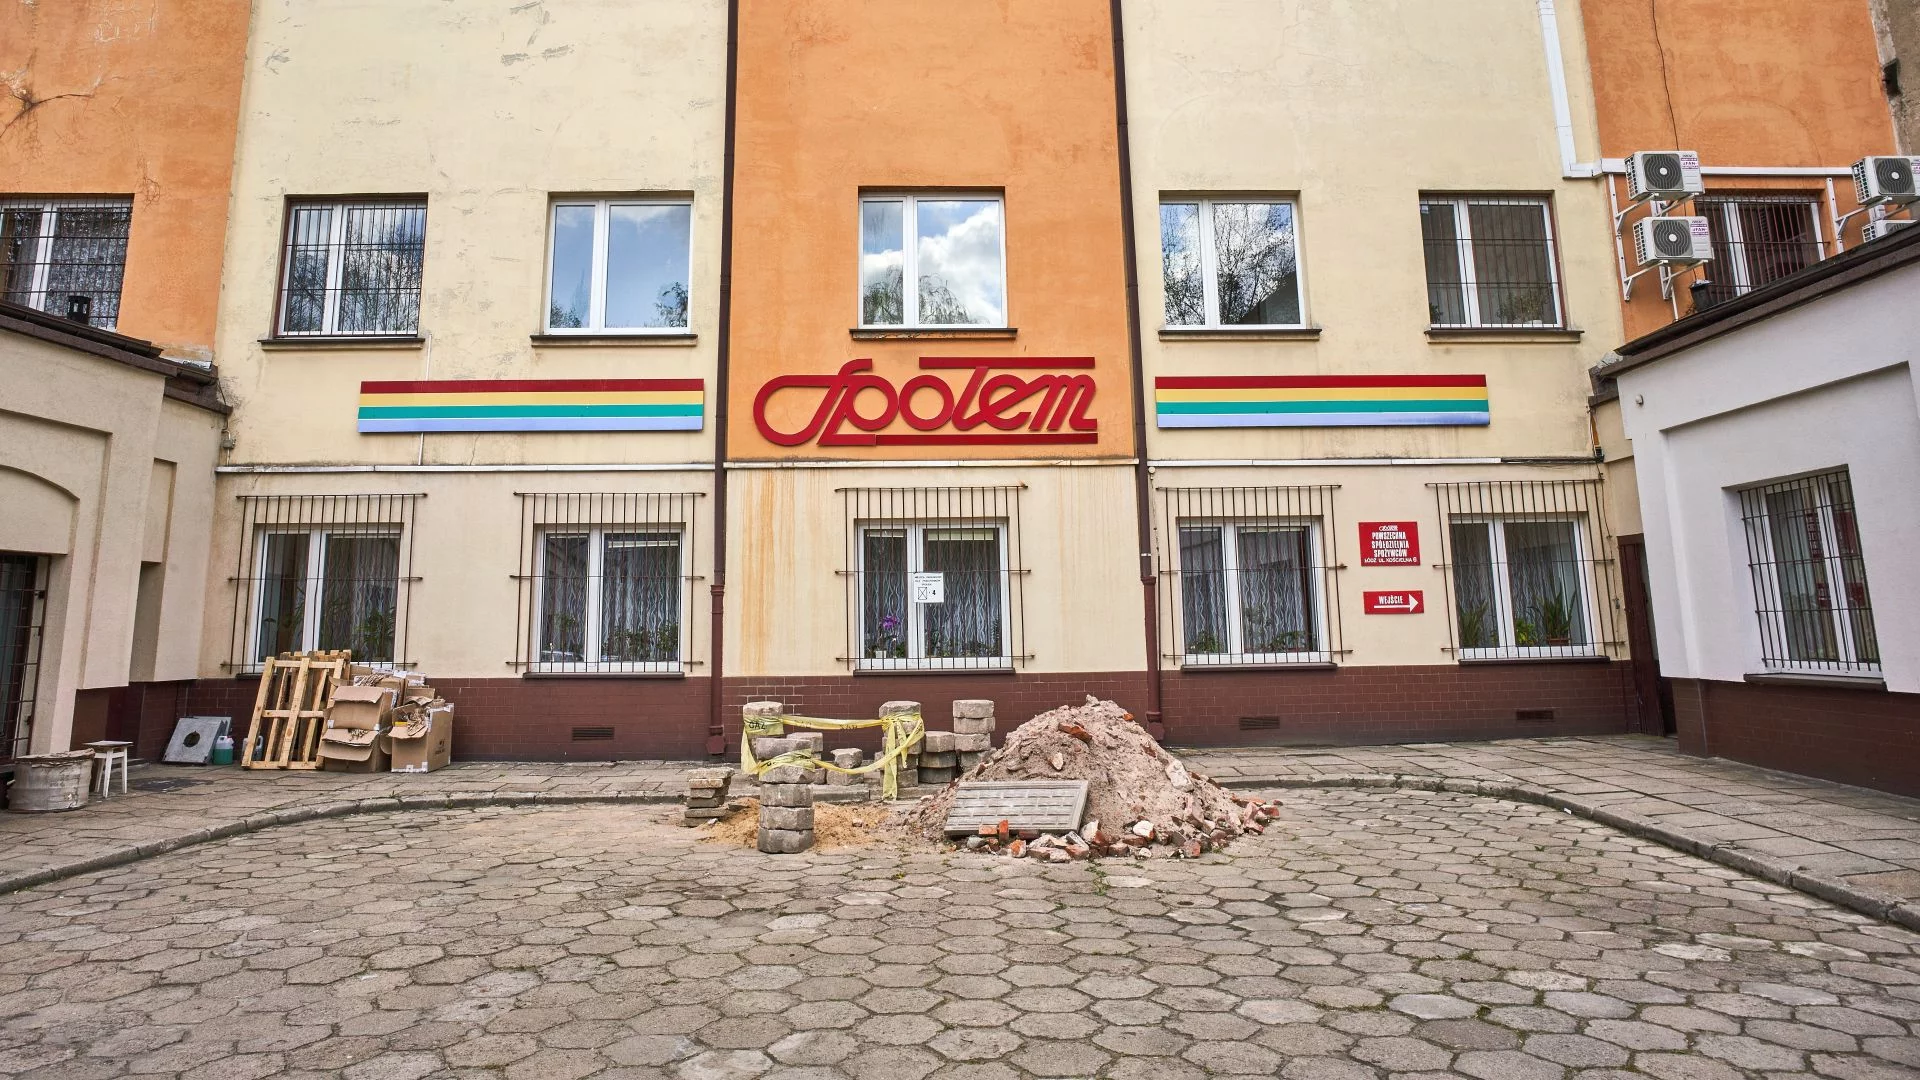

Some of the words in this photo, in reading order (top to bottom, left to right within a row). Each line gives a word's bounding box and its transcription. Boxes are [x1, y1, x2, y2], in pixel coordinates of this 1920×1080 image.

[1372, 532, 1406, 540] POWSZECHNA
[1372, 540, 1409, 548] SPÓŁDZIELNIA
[1373, 548, 1407, 557] SPOŻYWCÓW
[1378, 595, 1403, 604] WEJŚCIE
[748, 721, 766, 730] GAZ
